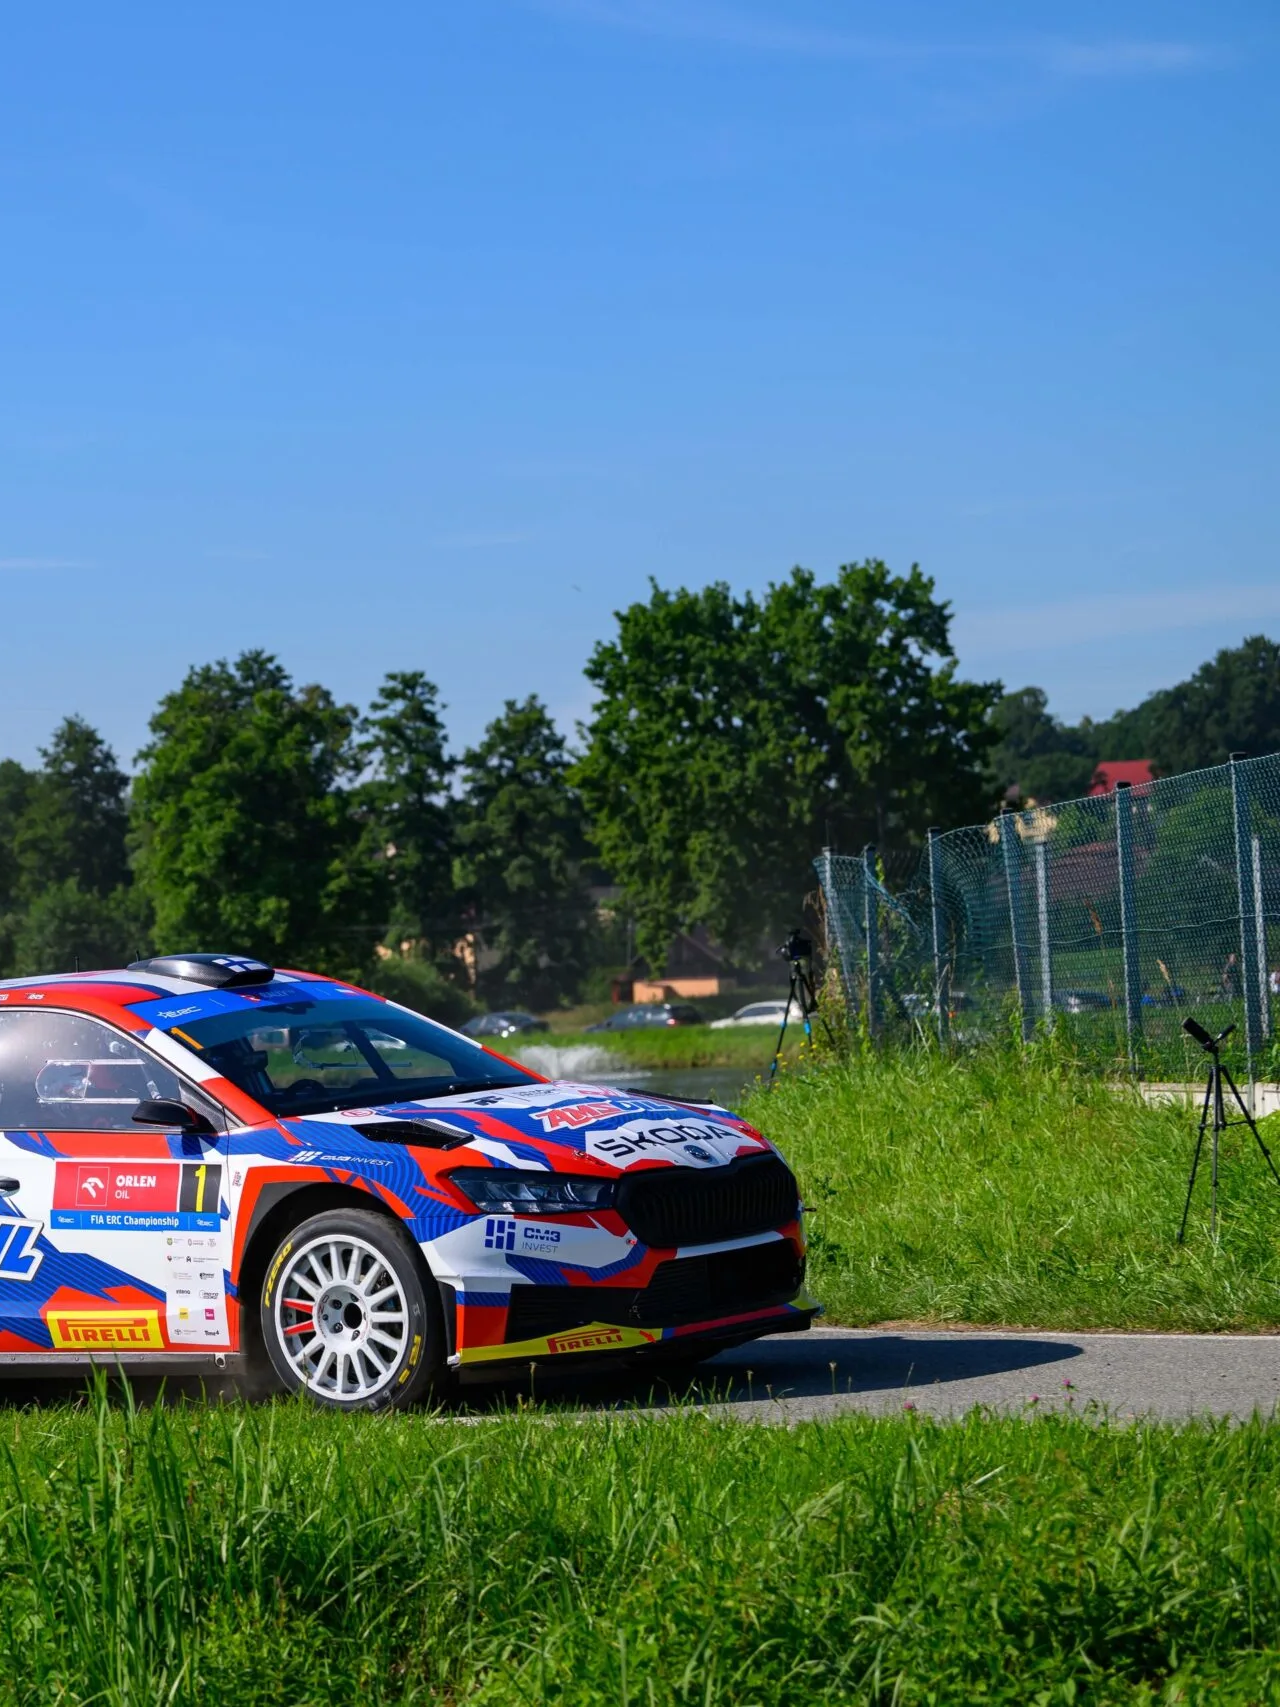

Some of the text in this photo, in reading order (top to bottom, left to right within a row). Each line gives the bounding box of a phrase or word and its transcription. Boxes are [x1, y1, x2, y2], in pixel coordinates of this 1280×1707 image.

[115, 1175, 157, 1188] ORLEN
[194, 1164, 207, 1213] 1
[114, 1190, 130, 1200] OIL
[90, 1214, 180, 1228] FIA ERC Championship
[521, 1241, 559, 1254] INVEST
[56, 1317, 151, 1343] PIRELLI
[546, 1327, 623, 1355] PIRELLI
